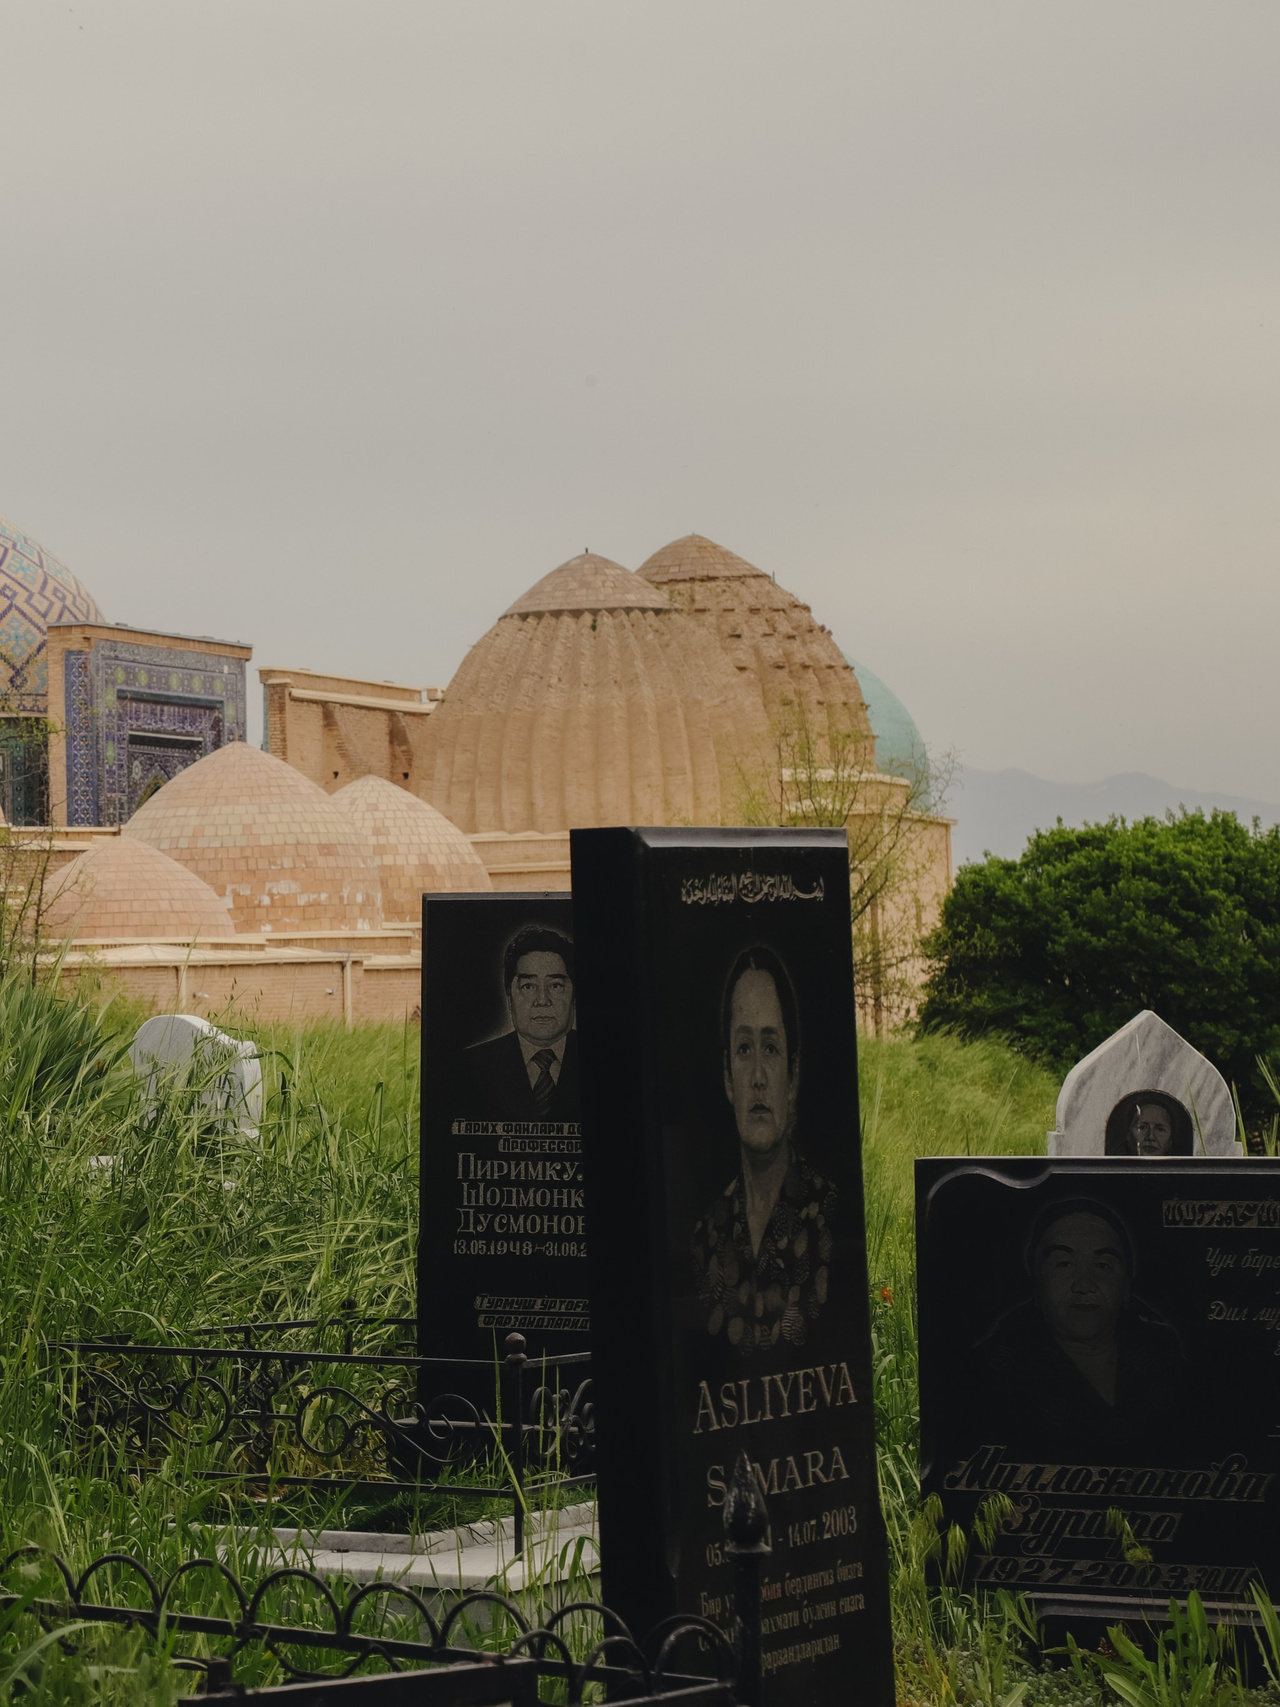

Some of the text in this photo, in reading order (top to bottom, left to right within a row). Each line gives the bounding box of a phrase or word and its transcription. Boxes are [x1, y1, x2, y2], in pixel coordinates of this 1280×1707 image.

[693, 1362, 858, 1434] ASLIYEVA
[706, 1446, 851, 1507] SMARA
[836, 1559, 864, 1583] бизга
